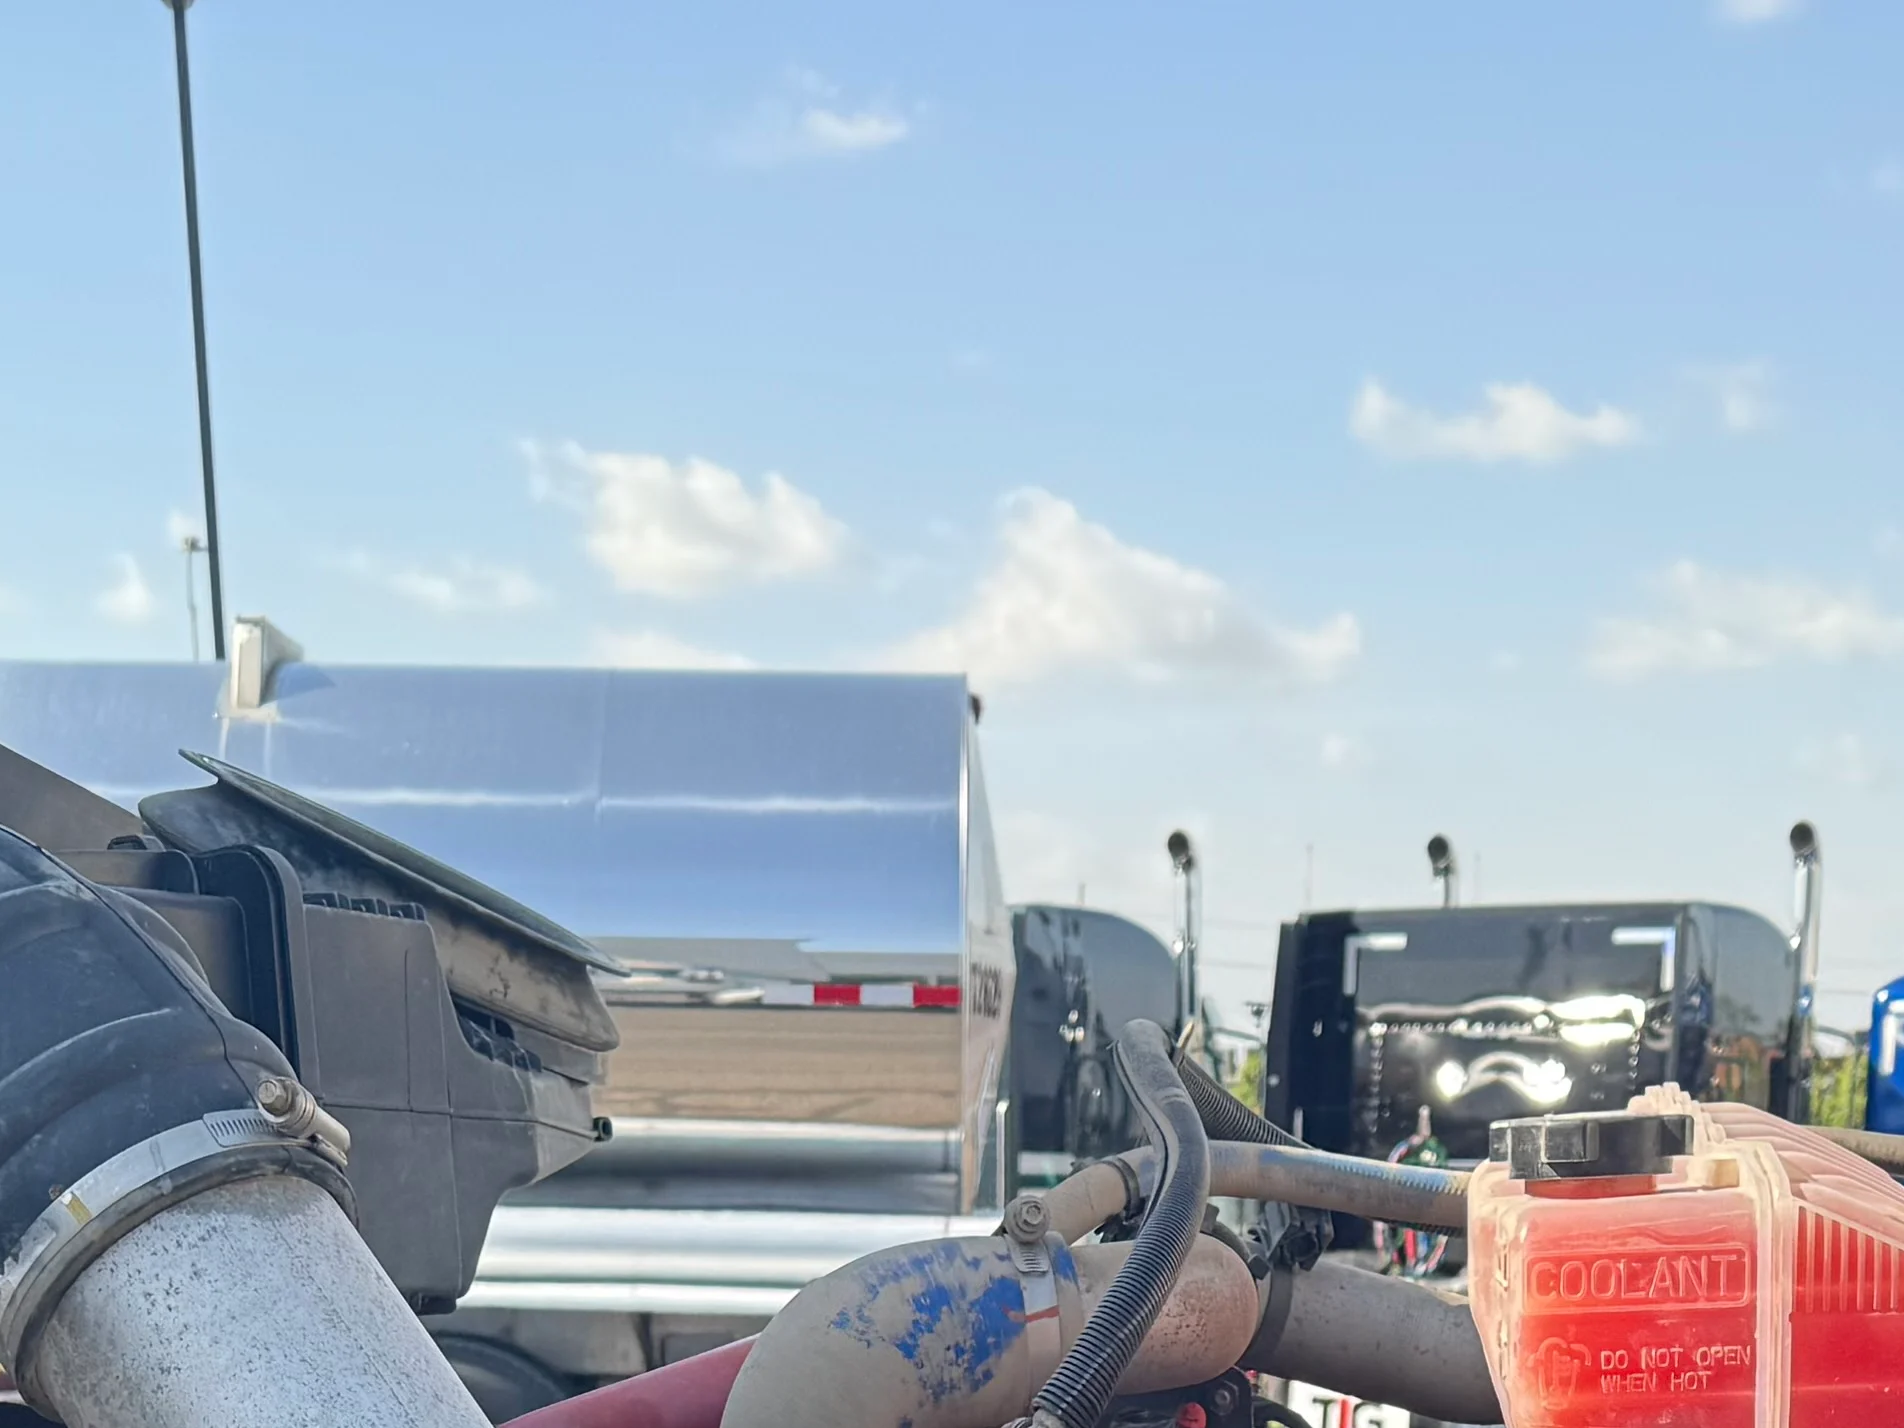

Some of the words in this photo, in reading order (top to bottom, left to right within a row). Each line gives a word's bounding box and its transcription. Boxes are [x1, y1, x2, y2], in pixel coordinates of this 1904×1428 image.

[1530, 1255, 1737, 1300] COOLANT
[1601, 1350, 1629, 1370] DO
[1641, 1346, 1683, 1369] NOT
[1695, 1345, 1752, 1367] OPEN
[1601, 1373, 1657, 1394] WHEN
[1670, 1371, 1712, 1392] HOT
